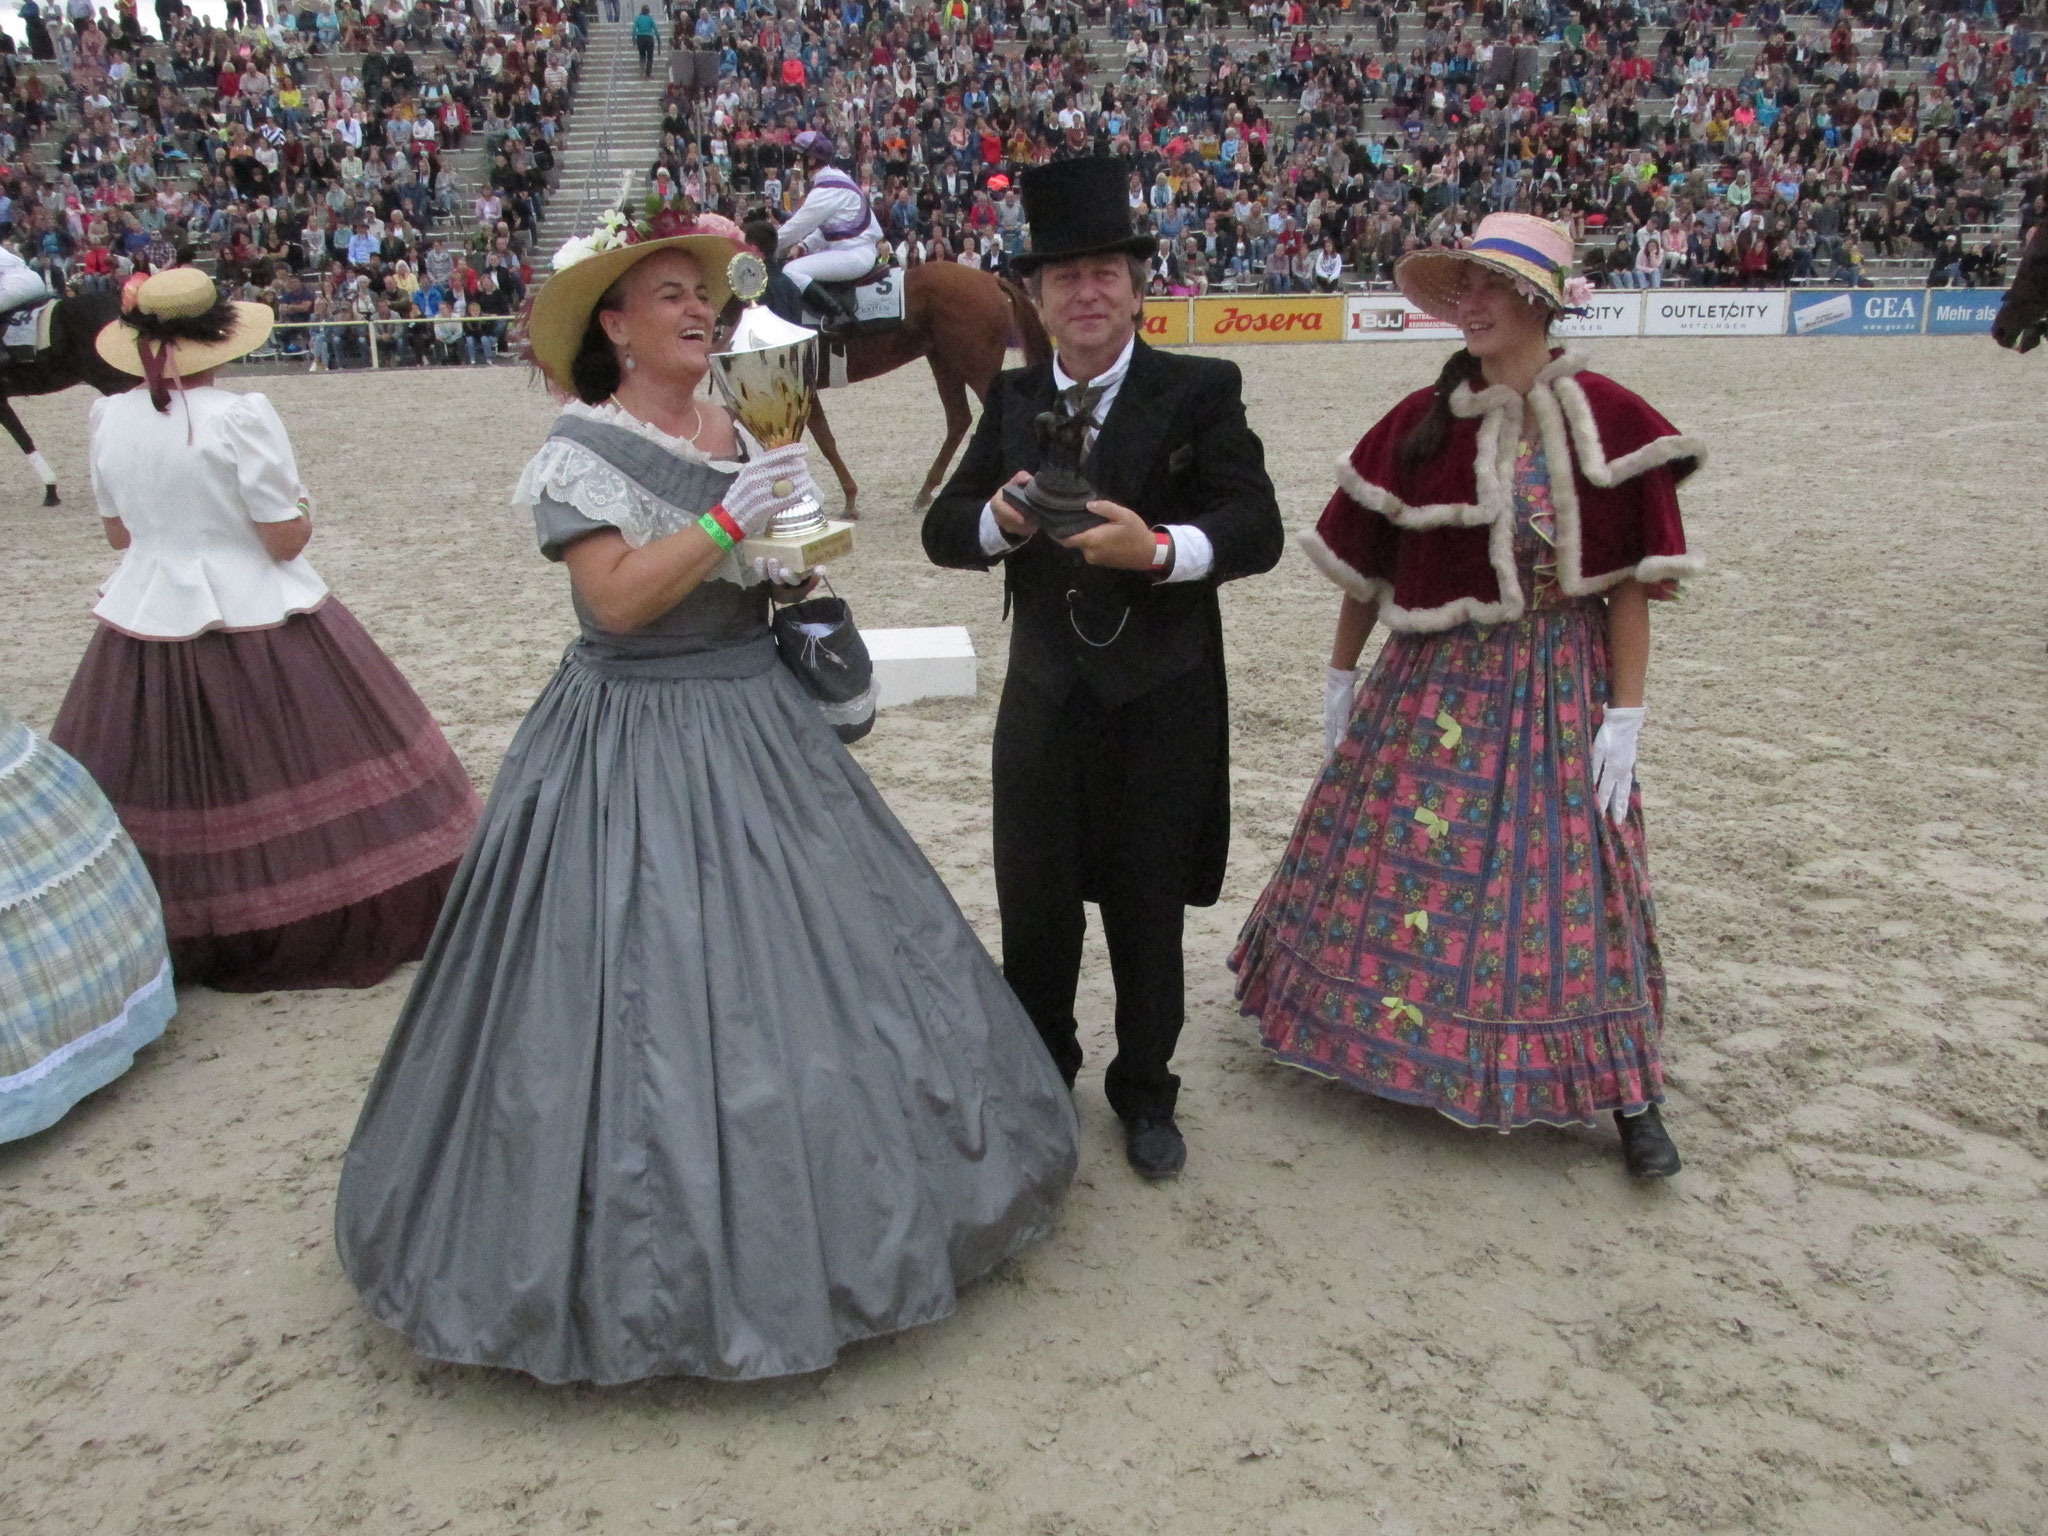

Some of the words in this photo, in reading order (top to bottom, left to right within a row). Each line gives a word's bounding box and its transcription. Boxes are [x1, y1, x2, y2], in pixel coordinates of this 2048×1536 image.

[1865, 297, 1916, 319] GEA
[1936, 305, 1973, 321] Mehr
[1975, 305, 1997, 321] als
[1214, 307, 1323, 334] Josera
[1362, 313, 1403, 328] BJJ
